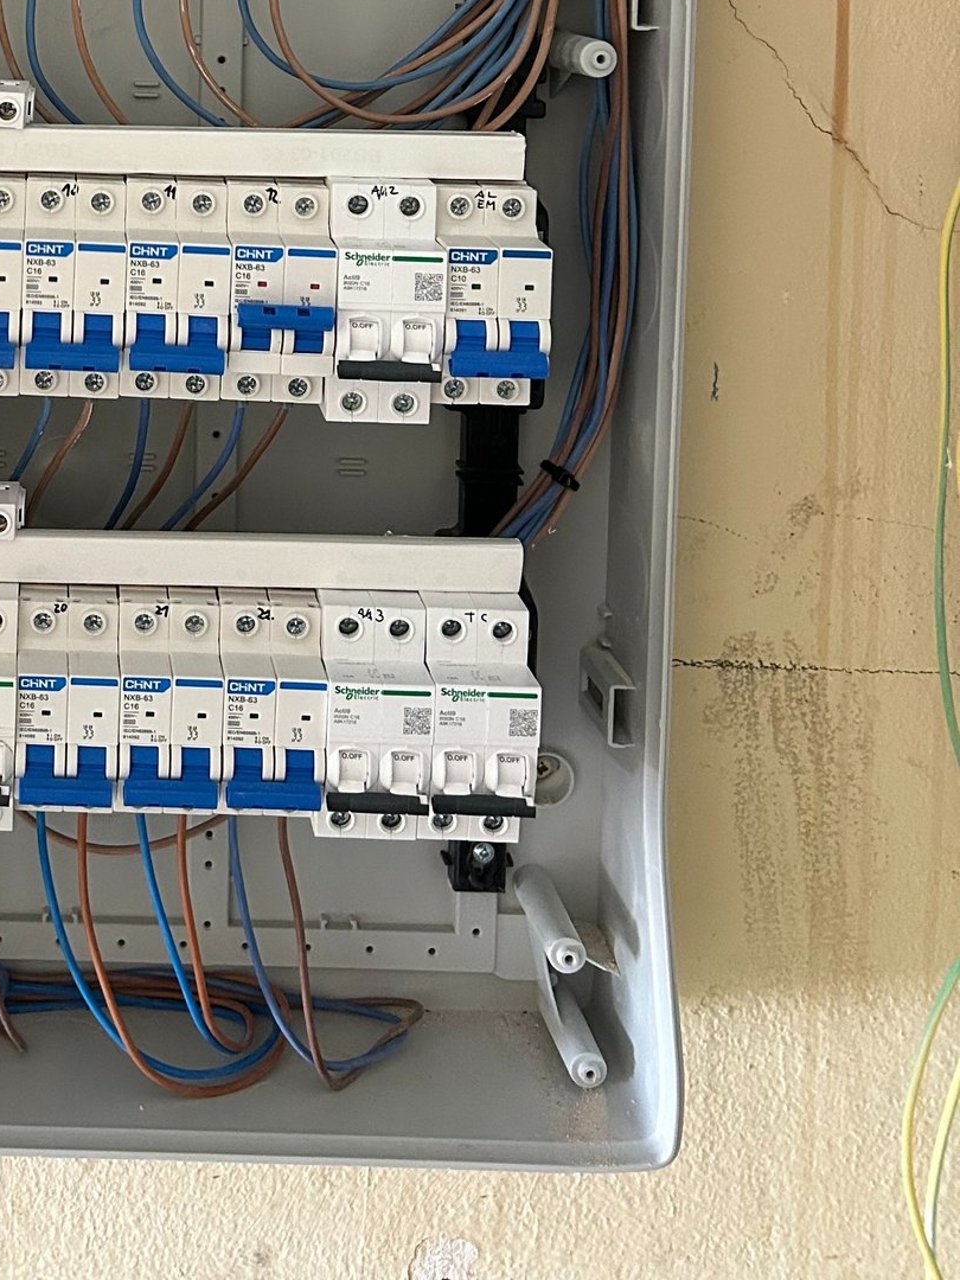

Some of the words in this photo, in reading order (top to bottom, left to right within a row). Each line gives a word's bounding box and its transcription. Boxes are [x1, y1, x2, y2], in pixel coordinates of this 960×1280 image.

[26, 258, 56, 267] NXB-63
[345, 251, 391, 267] Schneider
[130, 260, 160, 268] NXB-63
[235, 263, 266, 271] NXB-63
[450, 266, 481, 274] NXB-63
[375, 608, 385, 622] 3
[335, 685, 380, 700] Schneider
[441, 687, 486, 702] Schneider
[19, 693, 49, 701] NXB-63
[124, 694, 153, 702] NXB-63
[228, 695, 258, 703] NXB-63
